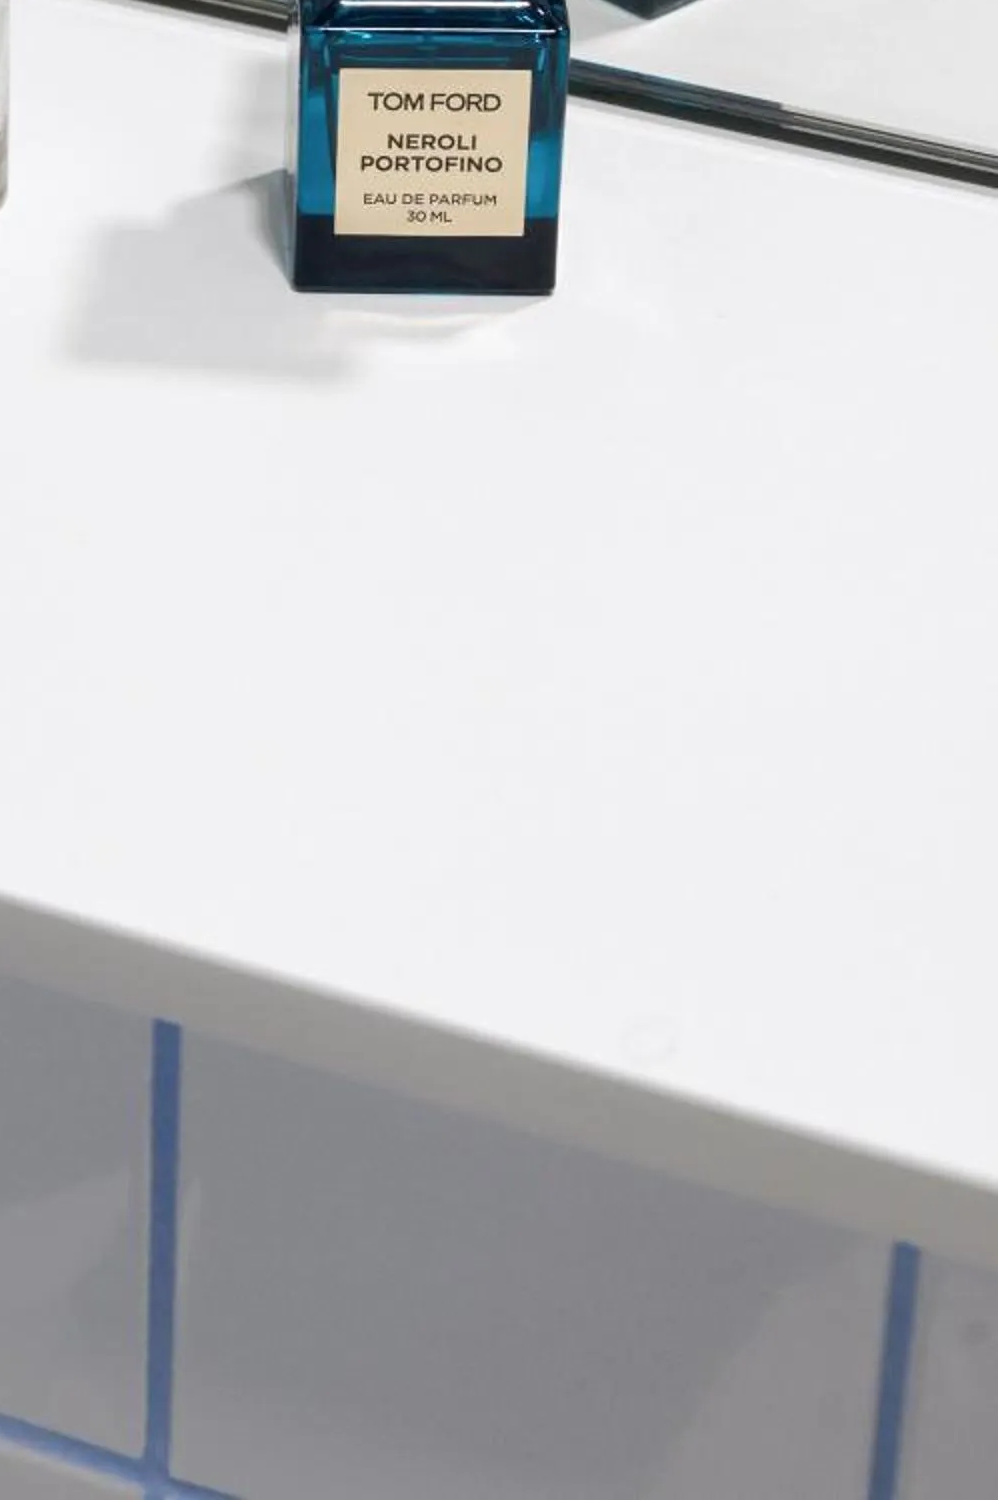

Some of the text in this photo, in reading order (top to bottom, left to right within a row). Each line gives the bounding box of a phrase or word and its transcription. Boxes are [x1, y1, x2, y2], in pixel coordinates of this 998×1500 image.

[367, 92, 502, 112] TOM FORD
[387, 133, 477, 150] NEROLI
[360, 155, 503, 173] PORTOFINO
[363, 193, 497, 206] EAU DE PARFUM
[407, 210, 453, 223] 30 ML
